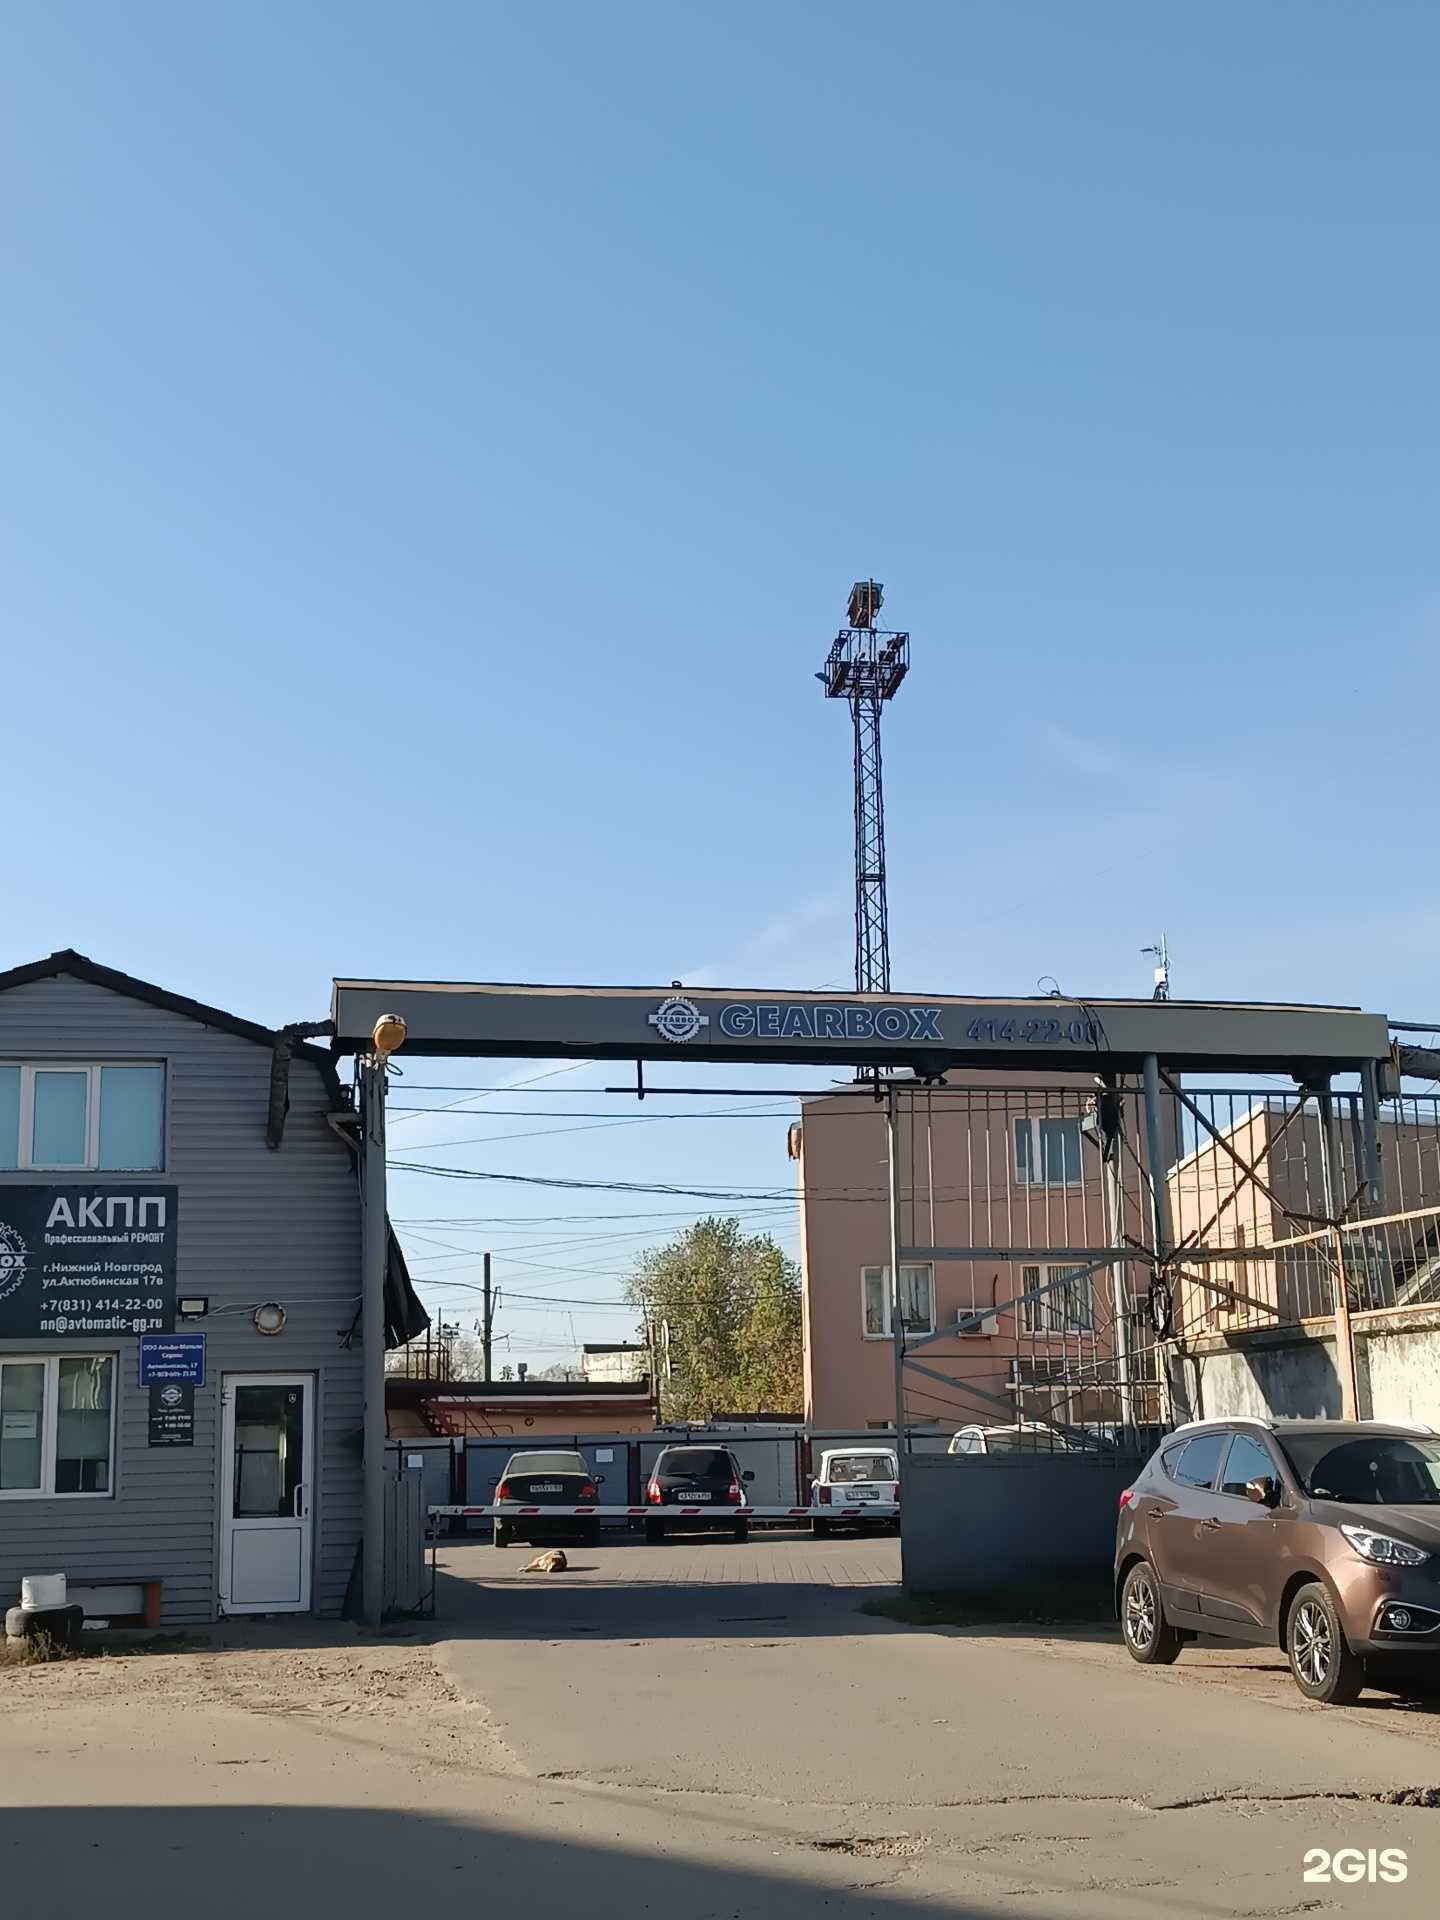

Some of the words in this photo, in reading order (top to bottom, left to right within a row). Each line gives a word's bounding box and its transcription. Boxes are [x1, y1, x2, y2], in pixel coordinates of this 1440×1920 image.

[720, 1004, 944, 1040] GEARBOX
[967, 1018, 1103, 1044] 414-22-00
[46, 1197, 166, 1228] АКПП
[44, 1232, 129, 1246] Профессиональный
[131, 1232, 165, 1243] РЕМОНТ
[43, 1262, 101, 1273] г.Нижний
[104, 1262, 163, 1274] Новгород
[42, 1276, 139, 1289] ул.Актюбинская
[40, 1299, 92, 1312] +7(831)
[95, 1299, 164, 1311] 414-22-00
[40, 1315, 163, 1333] nn@avtomatic-gg.ru
